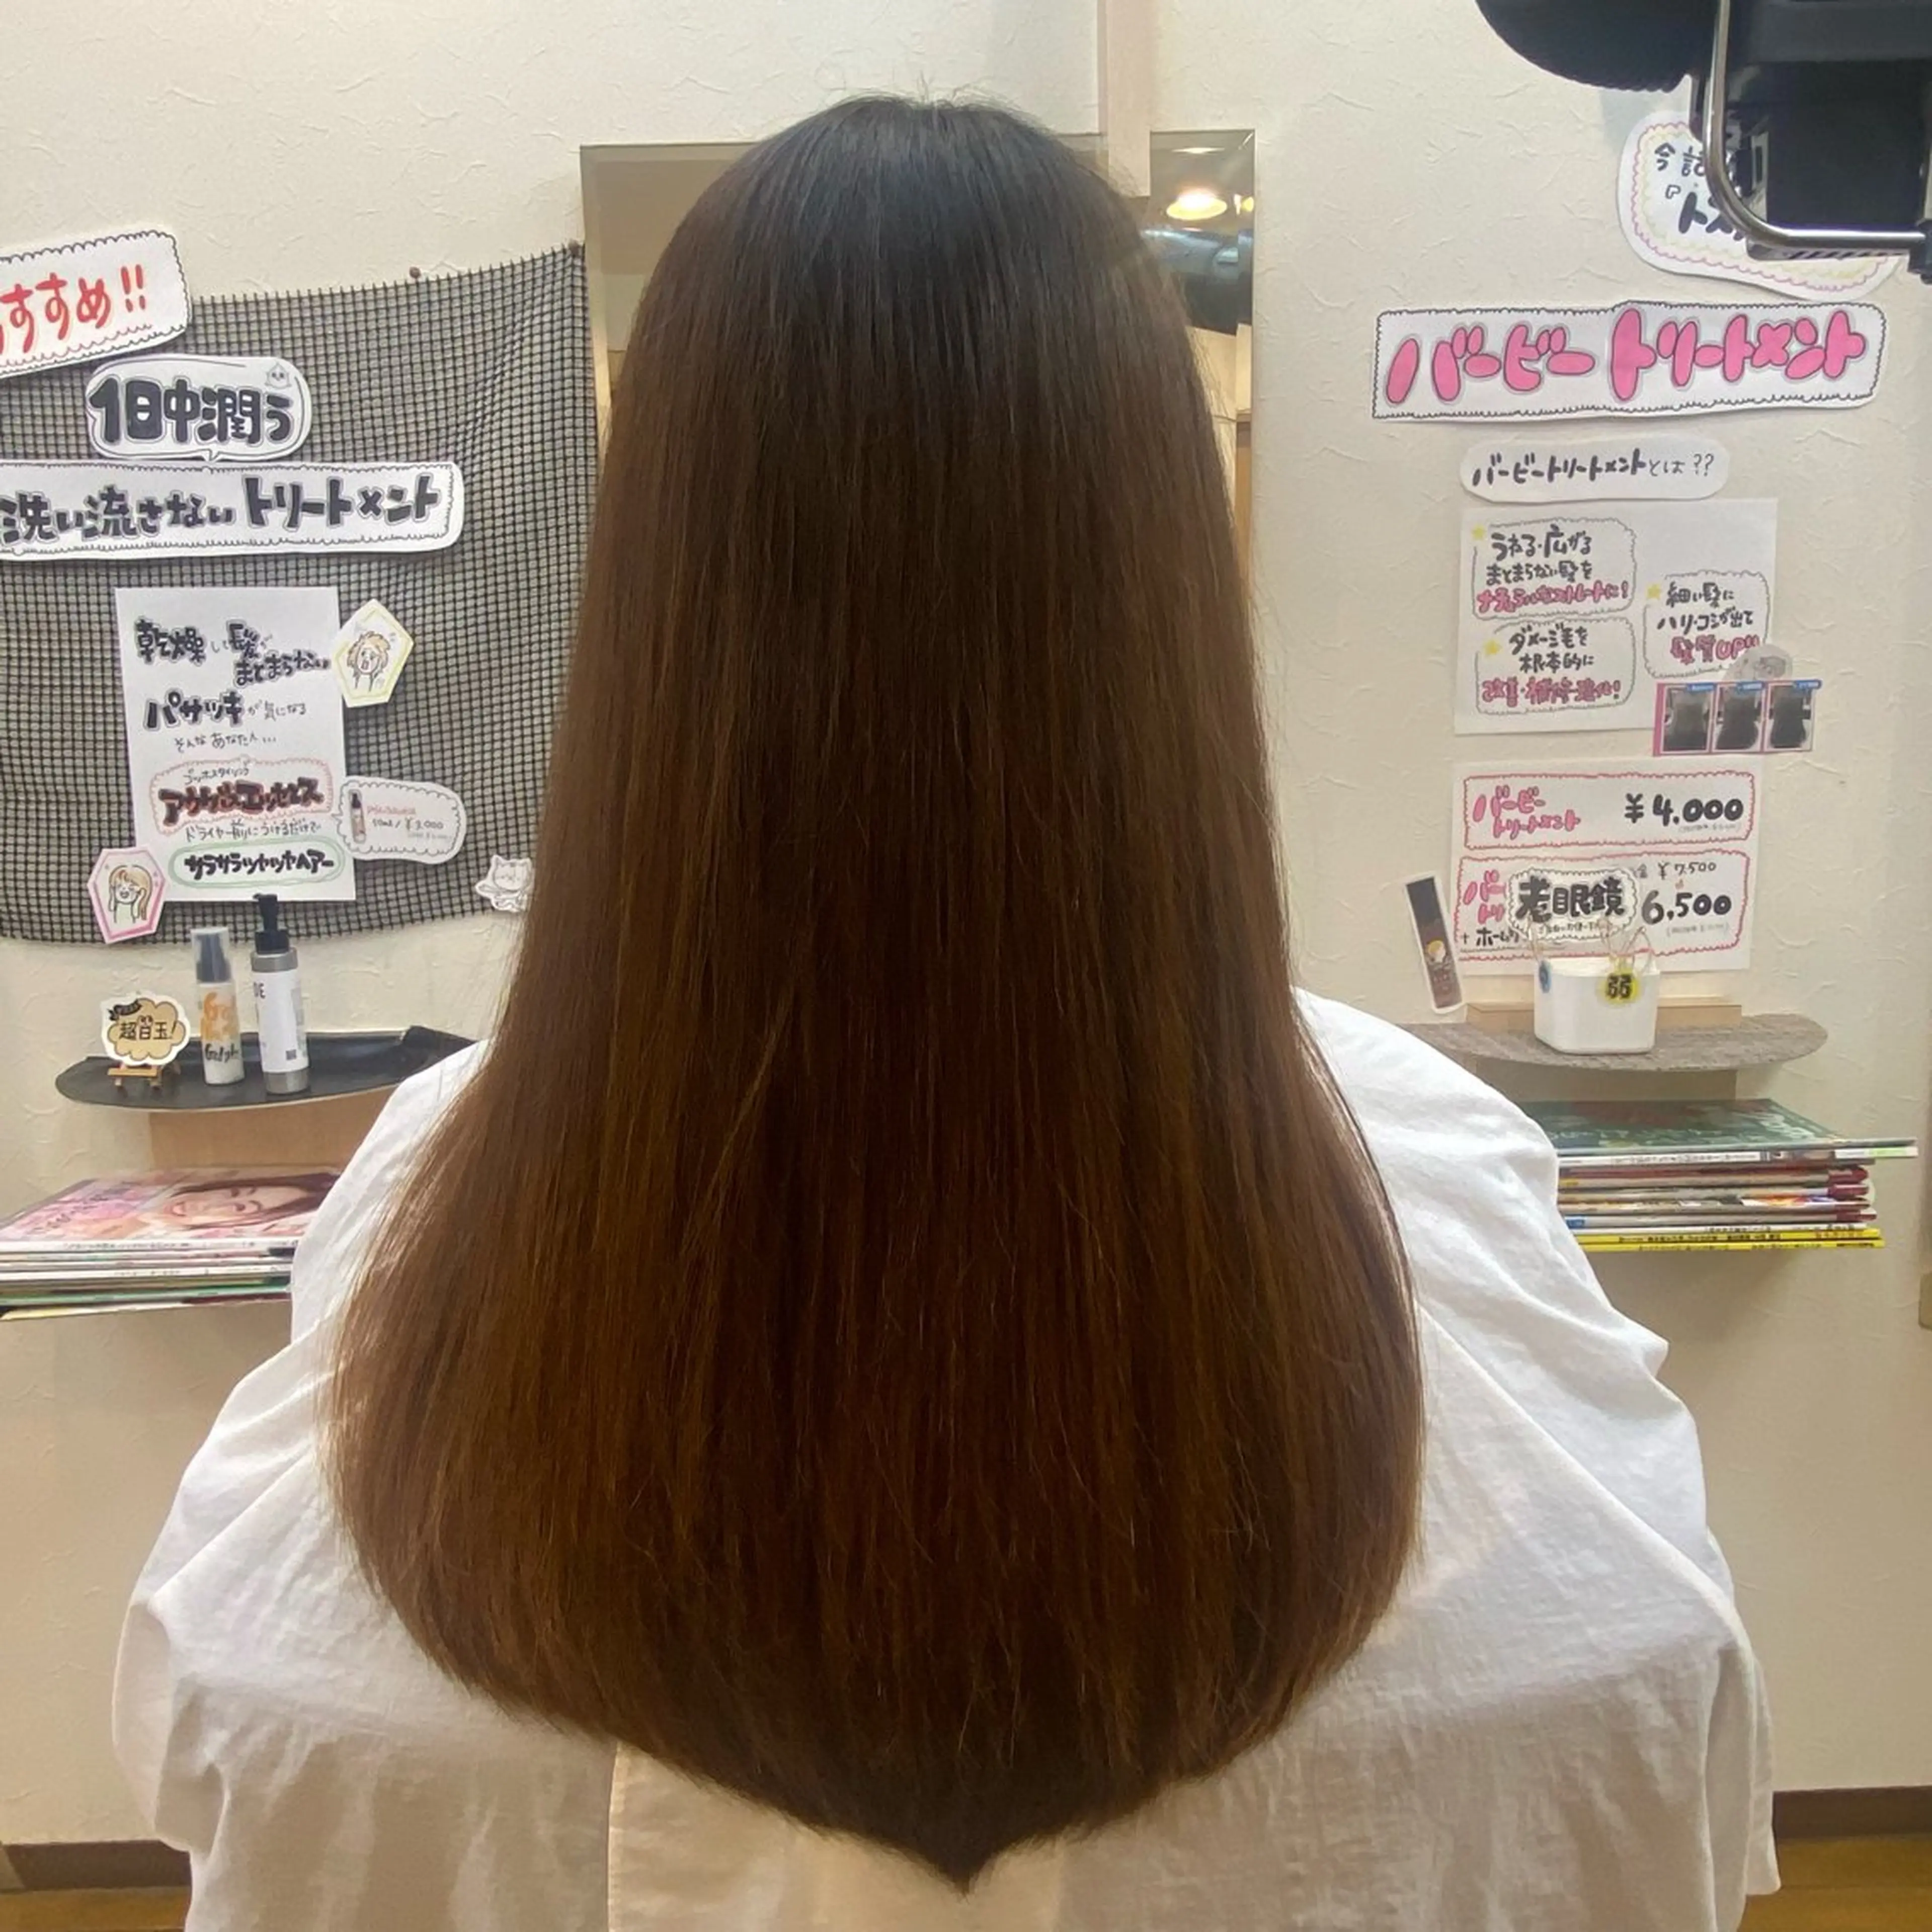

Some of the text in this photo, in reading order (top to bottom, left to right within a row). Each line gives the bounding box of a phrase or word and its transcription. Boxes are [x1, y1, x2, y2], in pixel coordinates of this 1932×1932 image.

[0, 264, 147, 354] すすめ!!
[1386, 308, 1866, 404] バービートリートメント
[89, 377, 294, 445] 1日中潤う
[1519, 651, 1595, 673] 根本的に
[1515, 875, 1625, 923] 老眼鏡
